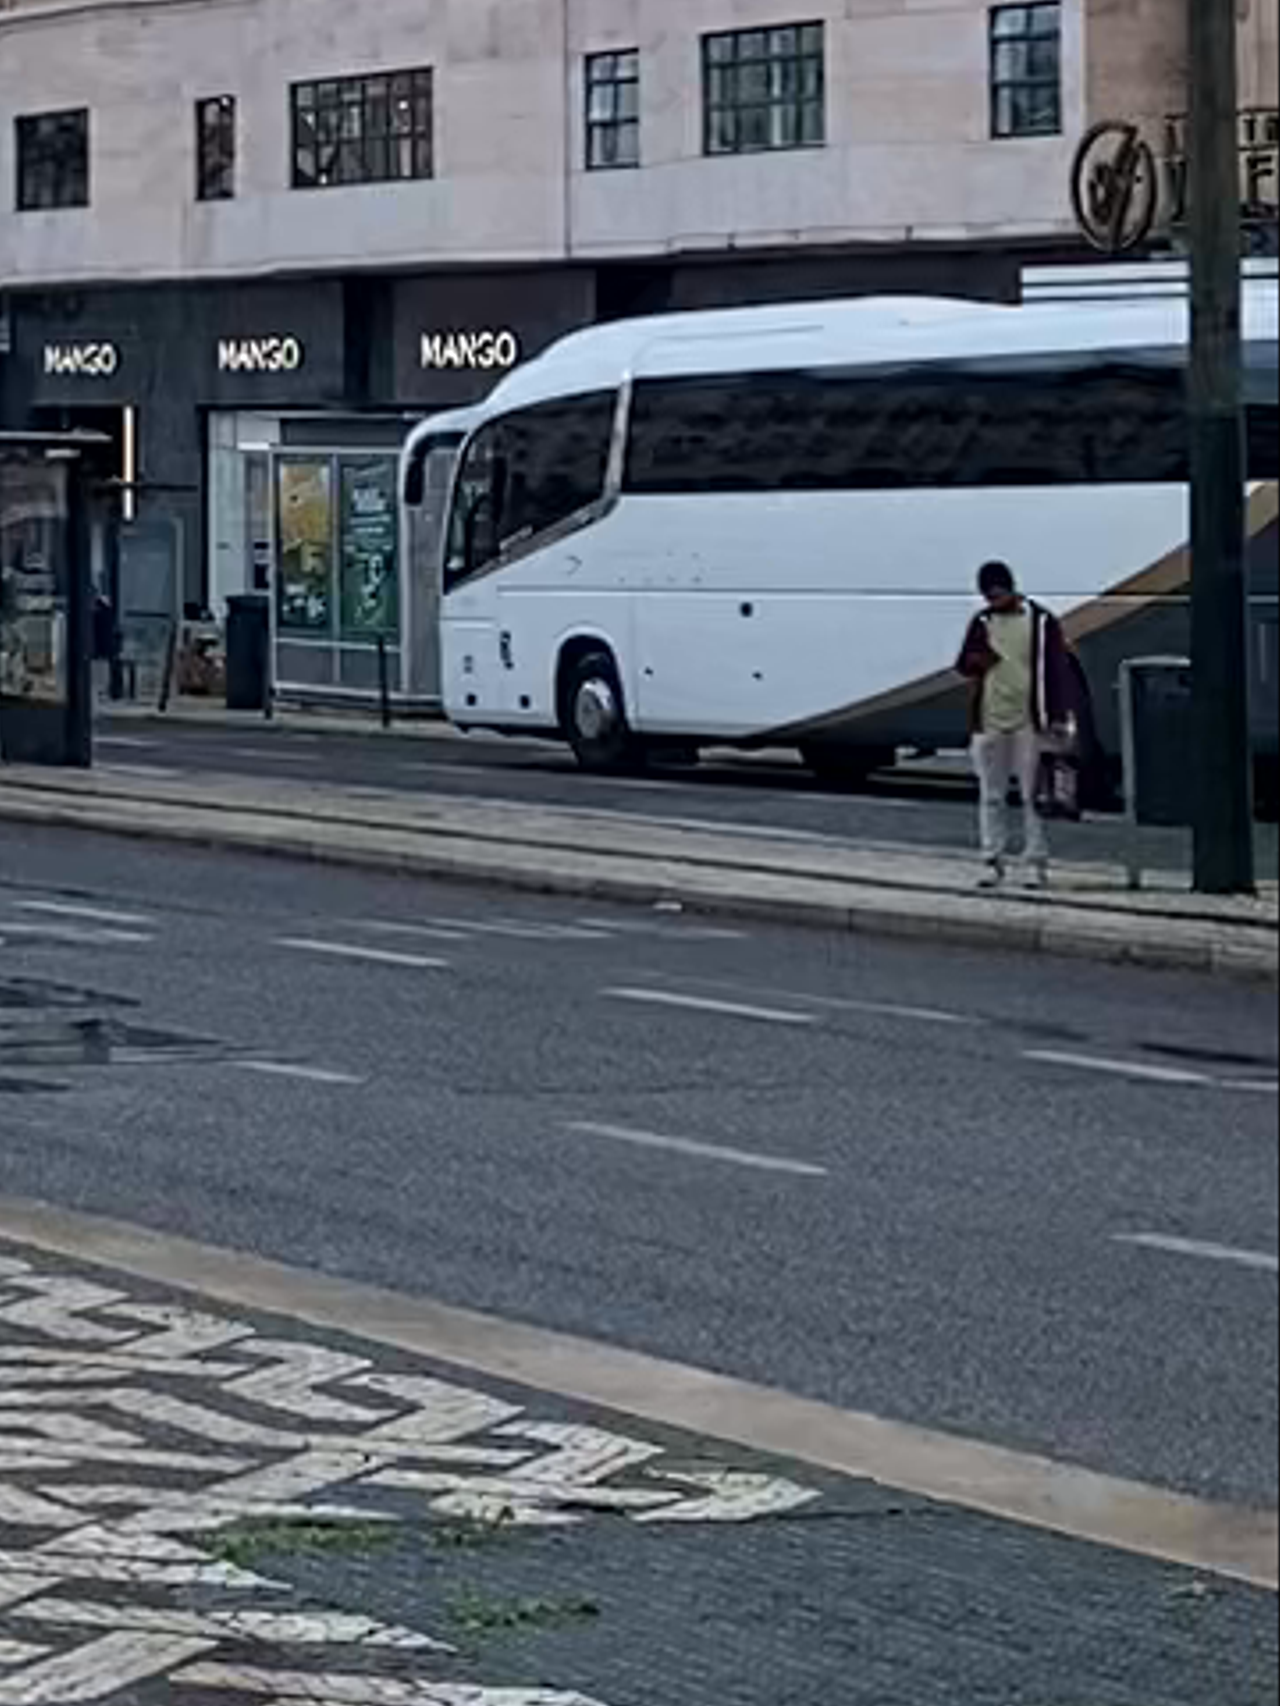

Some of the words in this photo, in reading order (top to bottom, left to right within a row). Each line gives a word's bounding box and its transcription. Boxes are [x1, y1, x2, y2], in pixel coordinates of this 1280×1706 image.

[43, 342, 118, 375] MANGO
[218, 337, 300, 371] MANGO
[420, 331, 517, 369] MANGO
